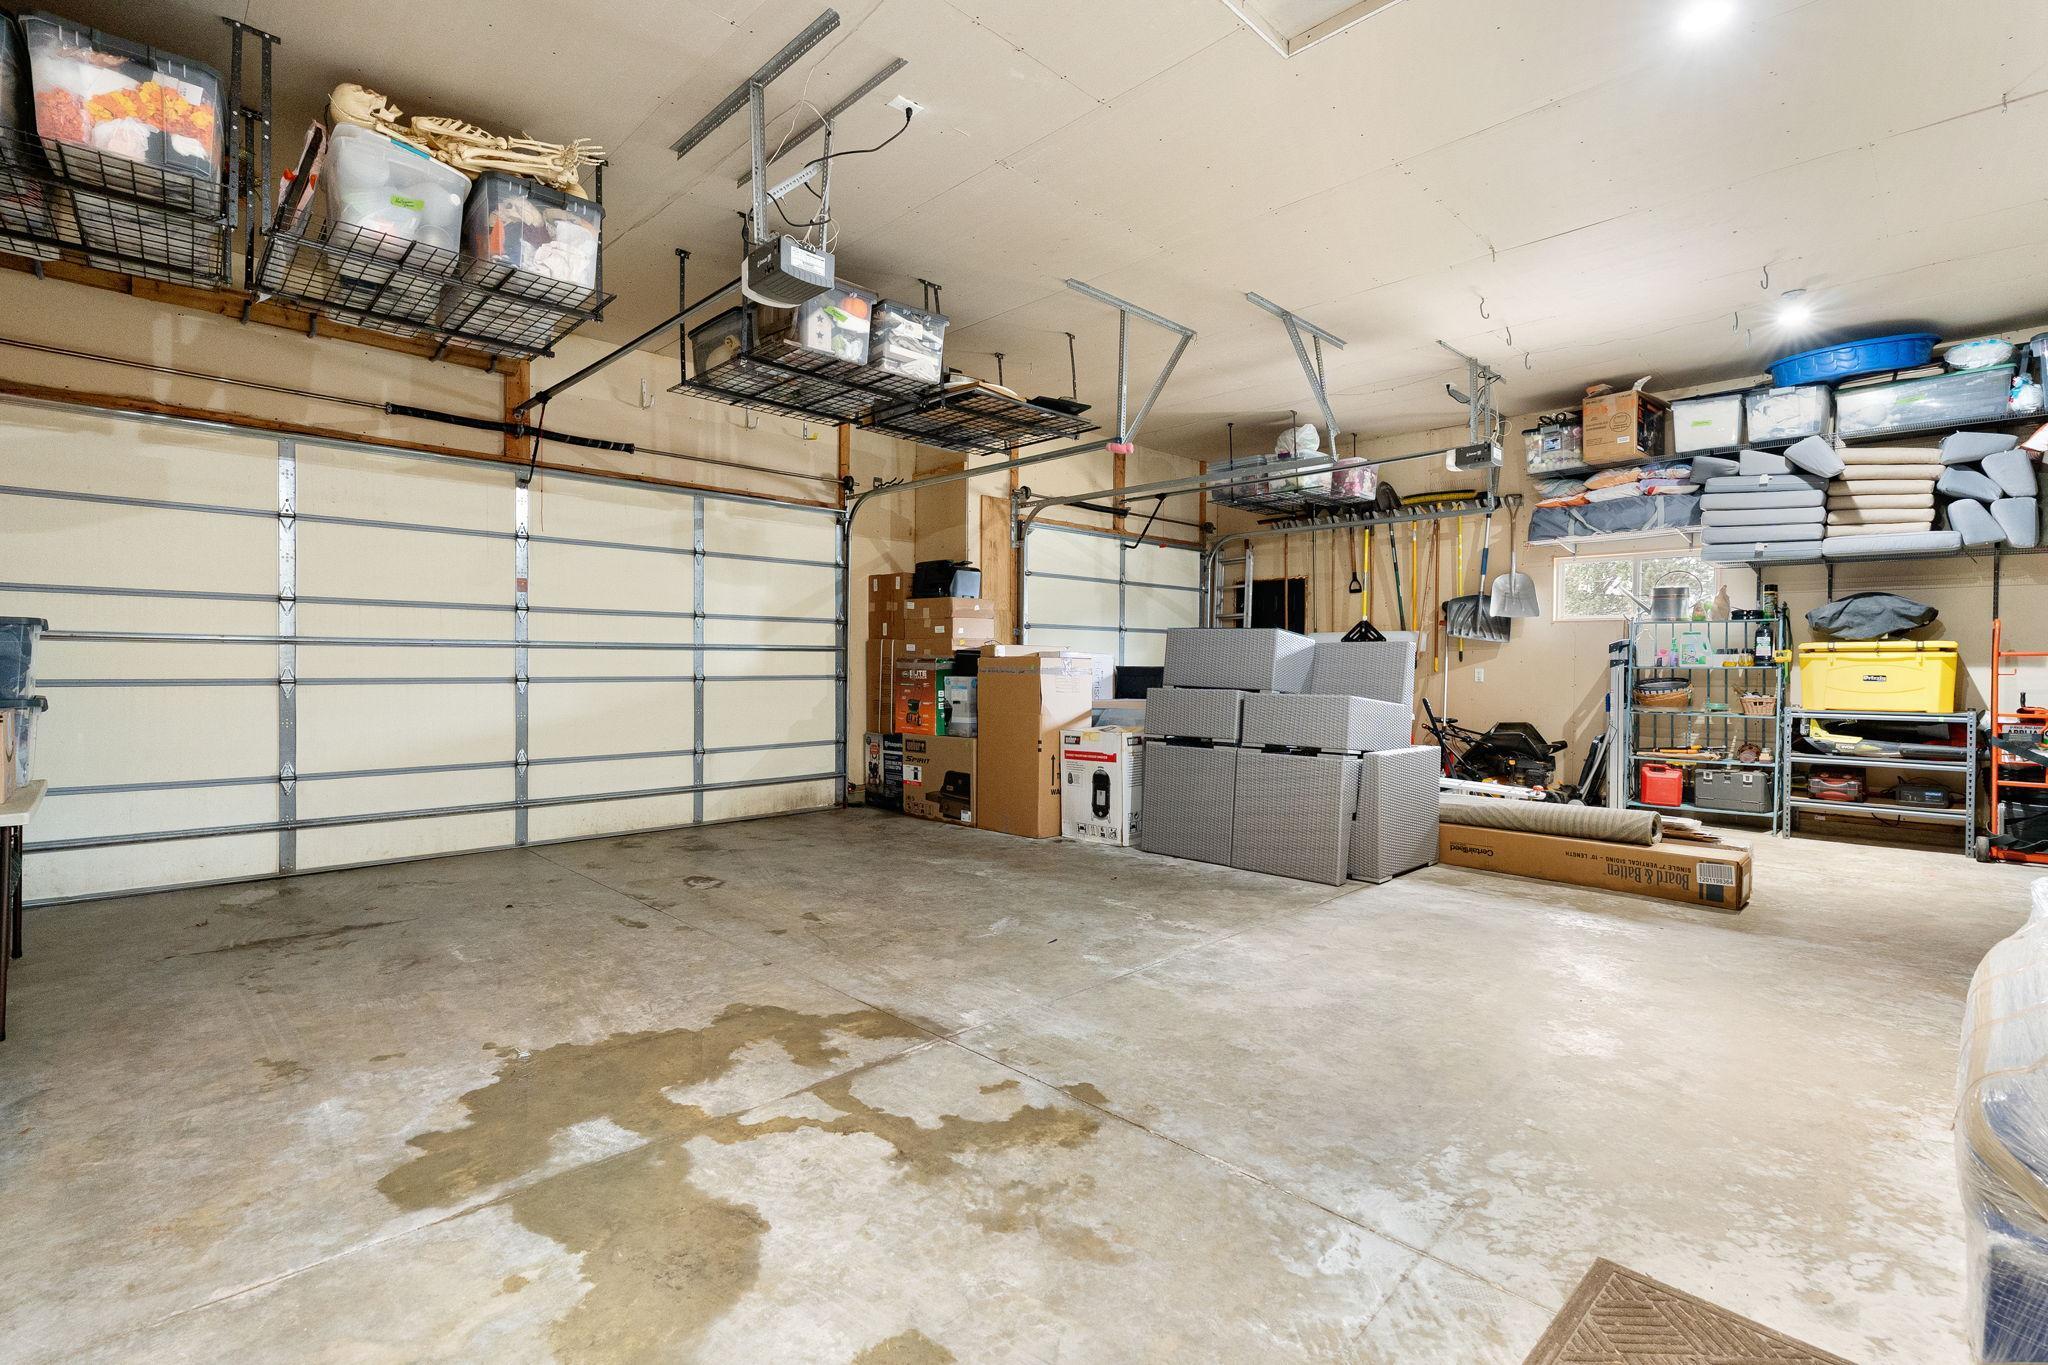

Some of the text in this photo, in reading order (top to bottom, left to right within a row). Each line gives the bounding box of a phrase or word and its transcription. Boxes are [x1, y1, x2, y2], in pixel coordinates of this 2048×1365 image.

[1565, 851, 1588, 859] LENGTH
[1605, 856, 1626, 864] SIDING
[1627, 859, 1658, 869] VERTICAL
[1668, 864, 1692, 874] SINGLE
[1606, 863, 1690, 891] Board & Batten
